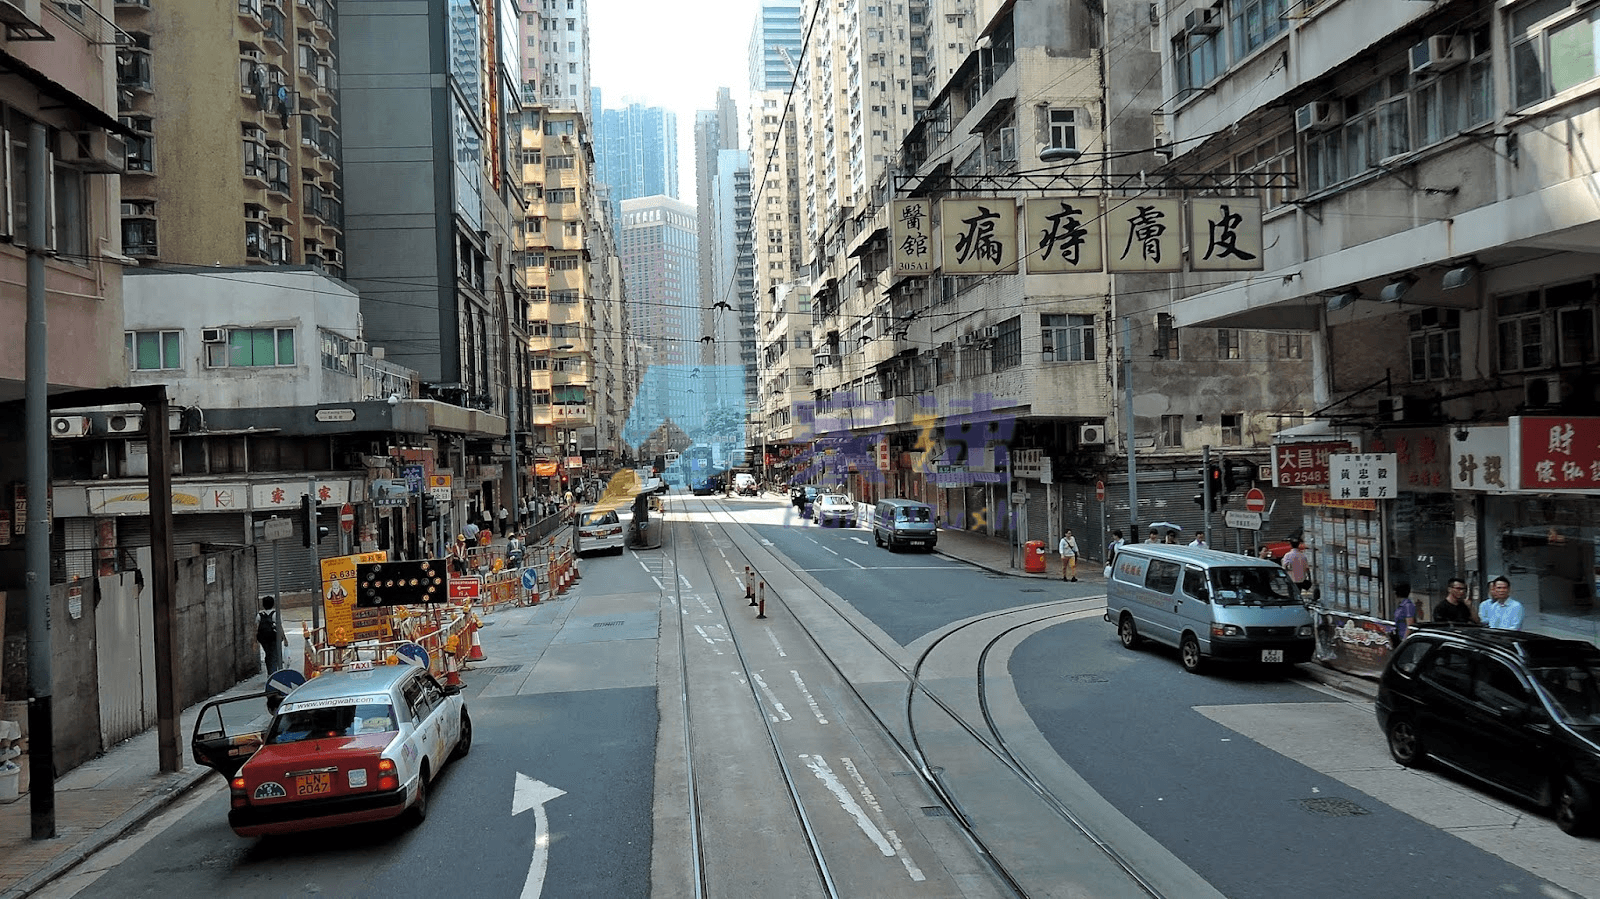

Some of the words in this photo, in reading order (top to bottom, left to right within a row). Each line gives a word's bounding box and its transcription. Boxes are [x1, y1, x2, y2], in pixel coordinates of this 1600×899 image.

[898, 262, 928, 271] 305A1
[1548, 423, 1575, 455] 財
[1294, 471, 1320, 483] 2548
[350, 661, 370, 670] TAXI
[297, 697, 374, 709] www.wingwah.com
[306, 775, 321, 786] LN
[298, 783, 328, 795] 2047
